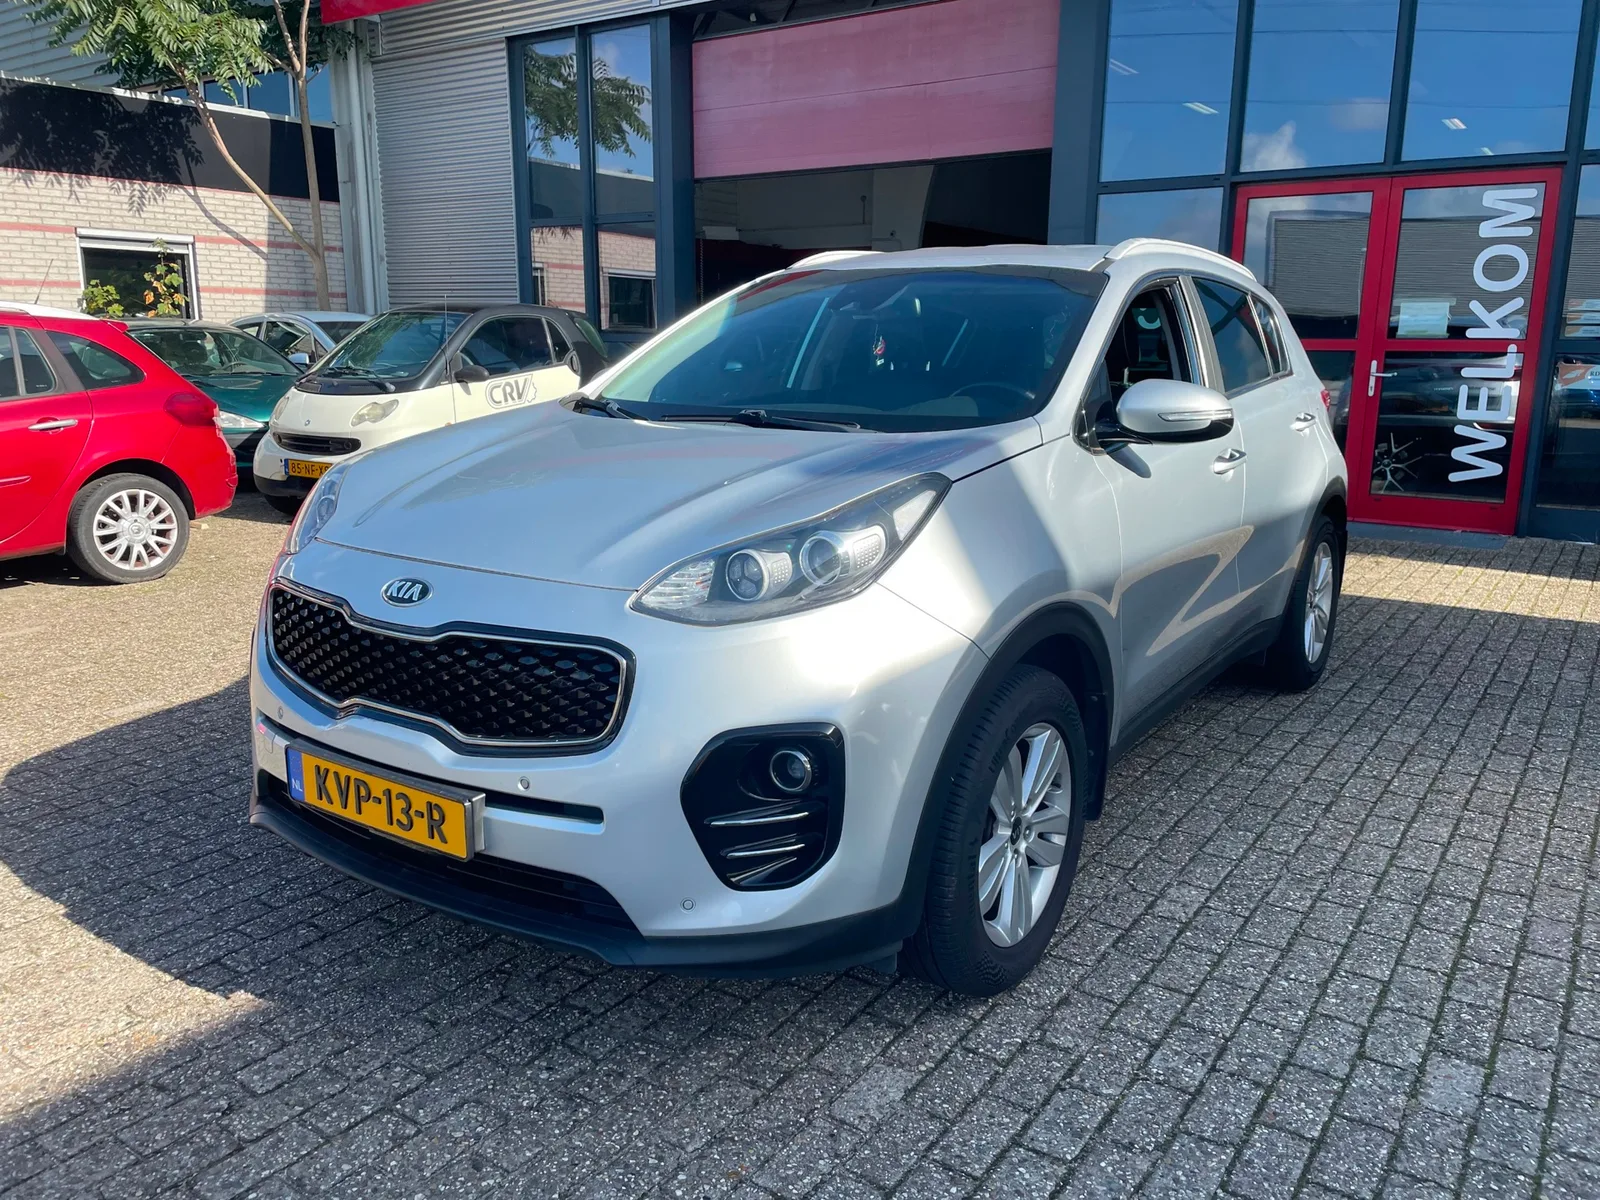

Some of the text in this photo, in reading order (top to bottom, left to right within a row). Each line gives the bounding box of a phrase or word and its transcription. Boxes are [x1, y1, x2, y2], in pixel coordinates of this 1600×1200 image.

[1448, 188, 1539, 482] WELKOM
[489, 377, 529, 404] CRV
[387, 580, 423, 601] KIA
[291, 778, 303, 792] NL
[314, 764, 448, 844] KVP-13-R
